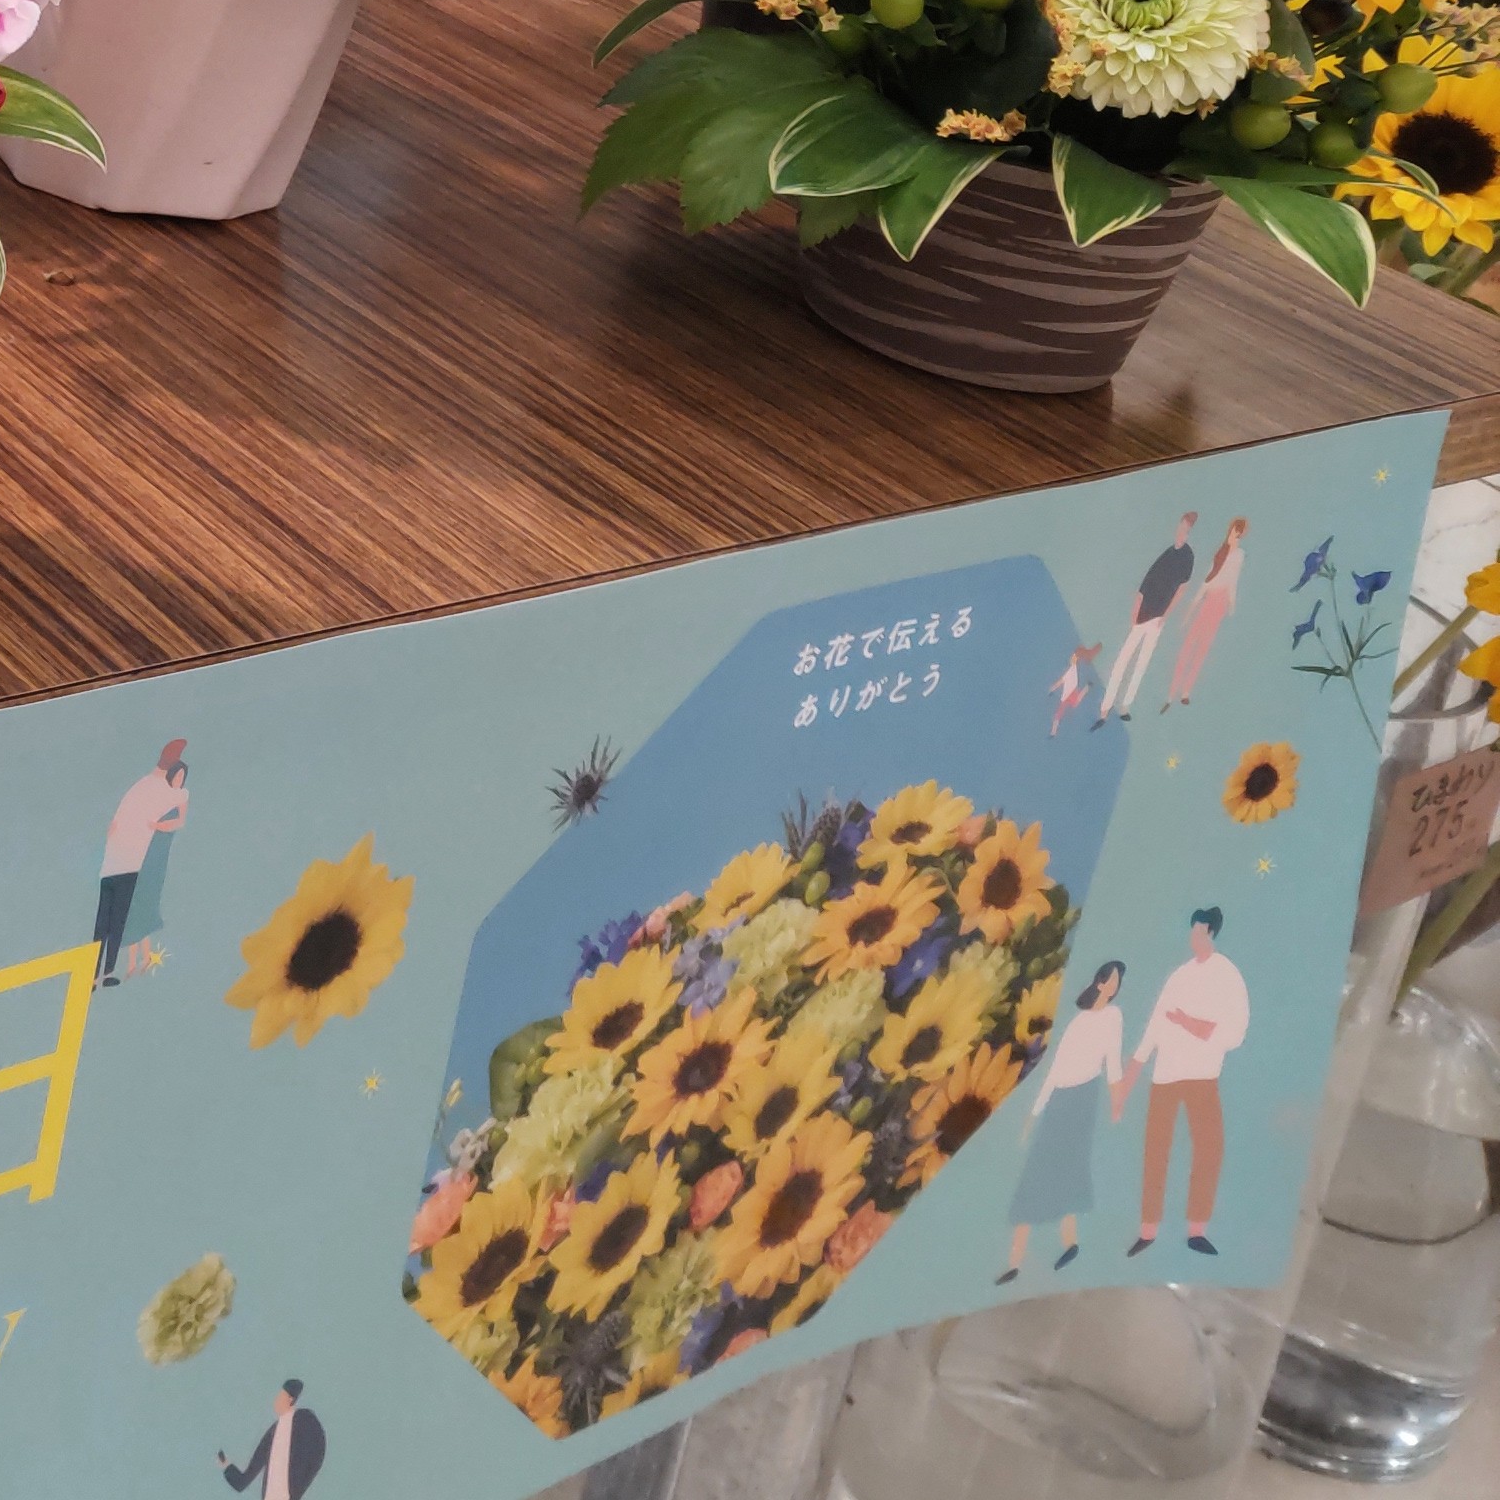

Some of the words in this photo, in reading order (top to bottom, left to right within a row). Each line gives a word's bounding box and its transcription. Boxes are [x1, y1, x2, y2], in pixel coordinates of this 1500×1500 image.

[792, 605, 974, 677] お花で伝える
[792, 662, 941, 730] ありがとう
